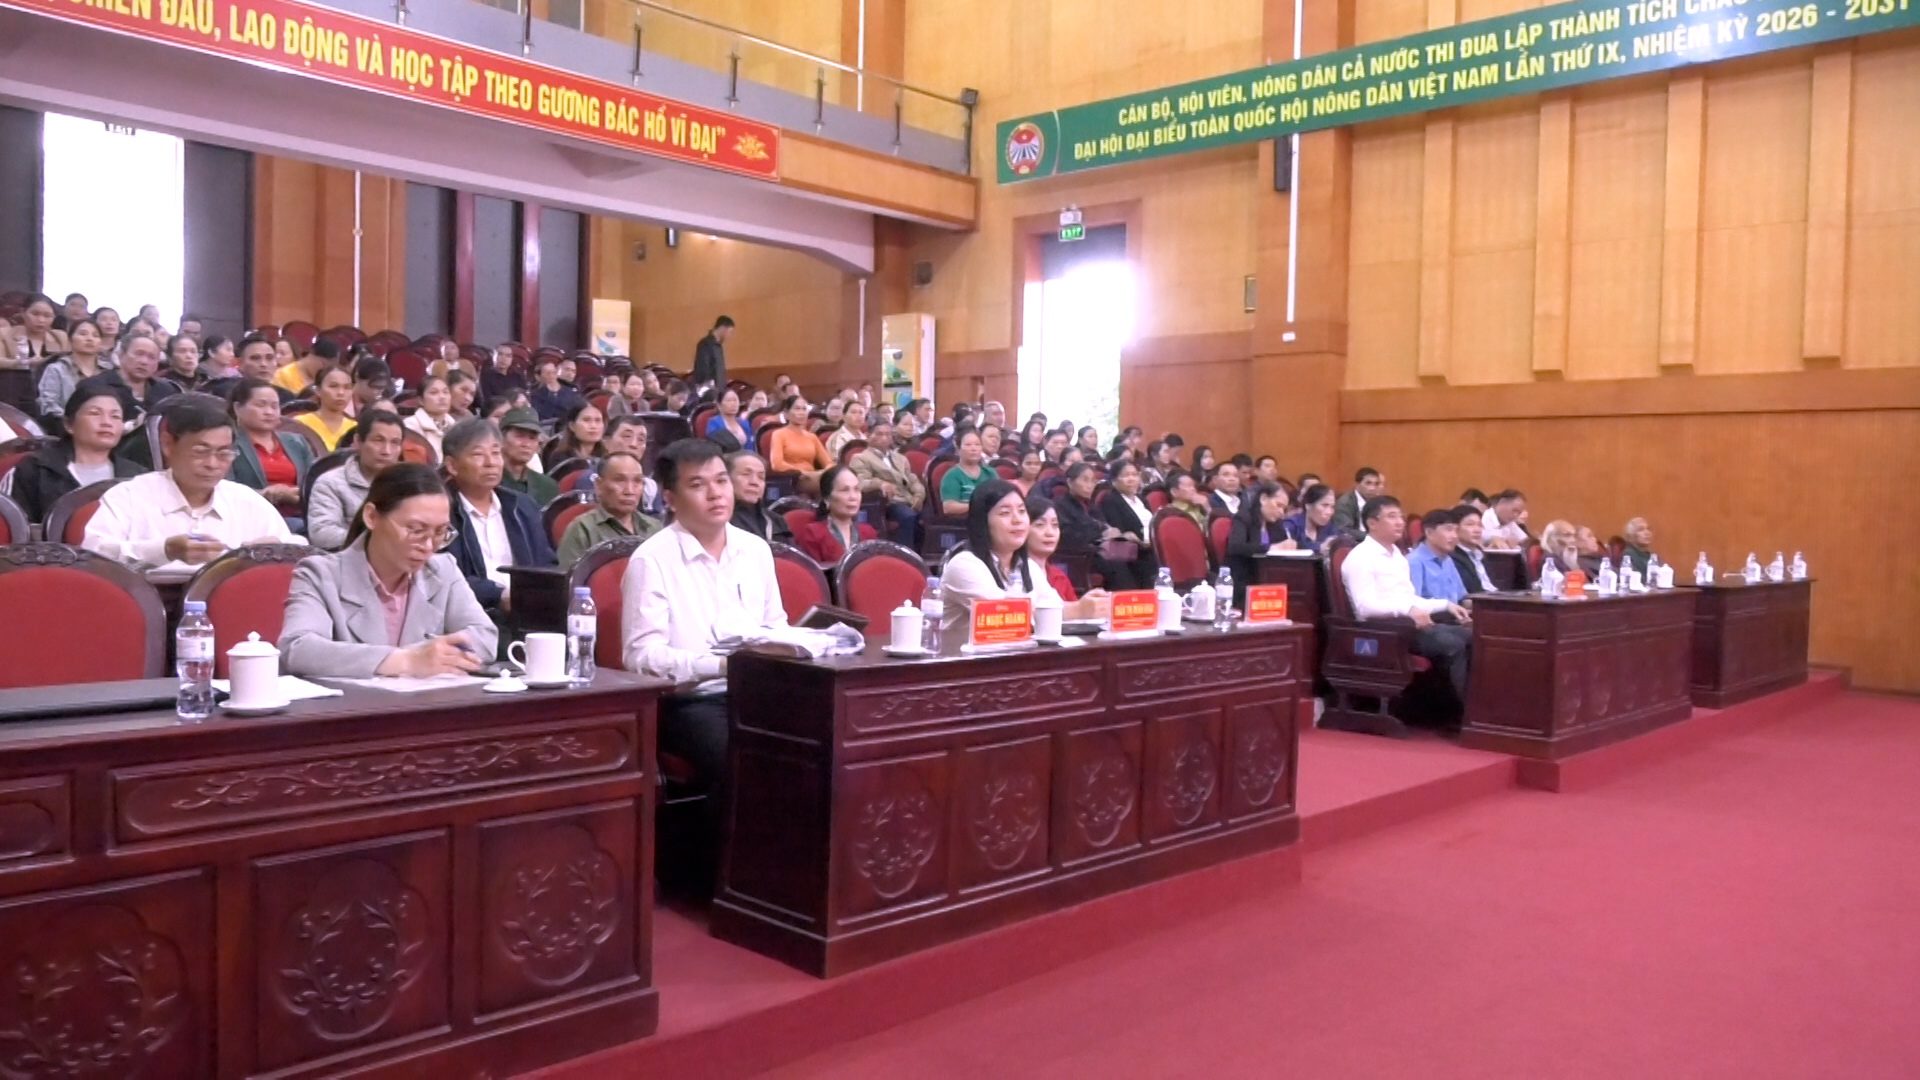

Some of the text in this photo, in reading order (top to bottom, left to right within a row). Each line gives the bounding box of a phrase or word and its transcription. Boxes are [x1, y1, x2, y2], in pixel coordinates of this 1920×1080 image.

[229, 4, 278, 51] LAO
[283, 15, 350, 68] ĐỘNG
[355, 33, 385, 76] VÀ
[390, 45, 435, 92] HỌC
[440, 55, 480, 102] TẬP
[483, 69, 533, 112] THEO
[537, 83, 601, 128] GƯƠNG
[605, 97, 640, 137] BÁC
[1074, 139, 1097, 162] ĐẠI
[1100, 133, 1124, 158] HỘI
[1126, 129, 1150, 152] ĐẠI
[1153, 117, 1187, 147] BIỂU
[1190, 113, 1230, 139] TOÀN
[1233, 101, 1277, 132] QUỐC
[1280, 97, 1309, 124] HỘI
[1312, 90, 1362, 117] NÔNG
[1365, 80, 1404, 107] DÂN
[1407, 71, 1449, 100] VIỆT
[1452, 62, 1500, 92] NAM
[1504, 51, 1546, 83] LẦN
[1551, 41, 1594, 73] THỨ
[1598, 41, 1627, 65] IX,
[1633, 23, 1711, 58] NHIỆM
[1755, 3, 1819, 37] 2026
[1118, 103, 1148, 126] CÁN
[1178, 90, 1204, 116] HỘI
[1251, 75, 1298, 100] NÔNG
[1301, 64, 1338, 90] DÂN
[1341, 53, 1366, 82] CẢ
[1369, 47, 1421, 76] NƯỚC
[1425, 41, 1455, 66] THI
[1460, 32, 1499, 60] ĐUA
[1504, 22, 1544, 51] LẬP
[1549, 8, 1621, 41] THÀNH
